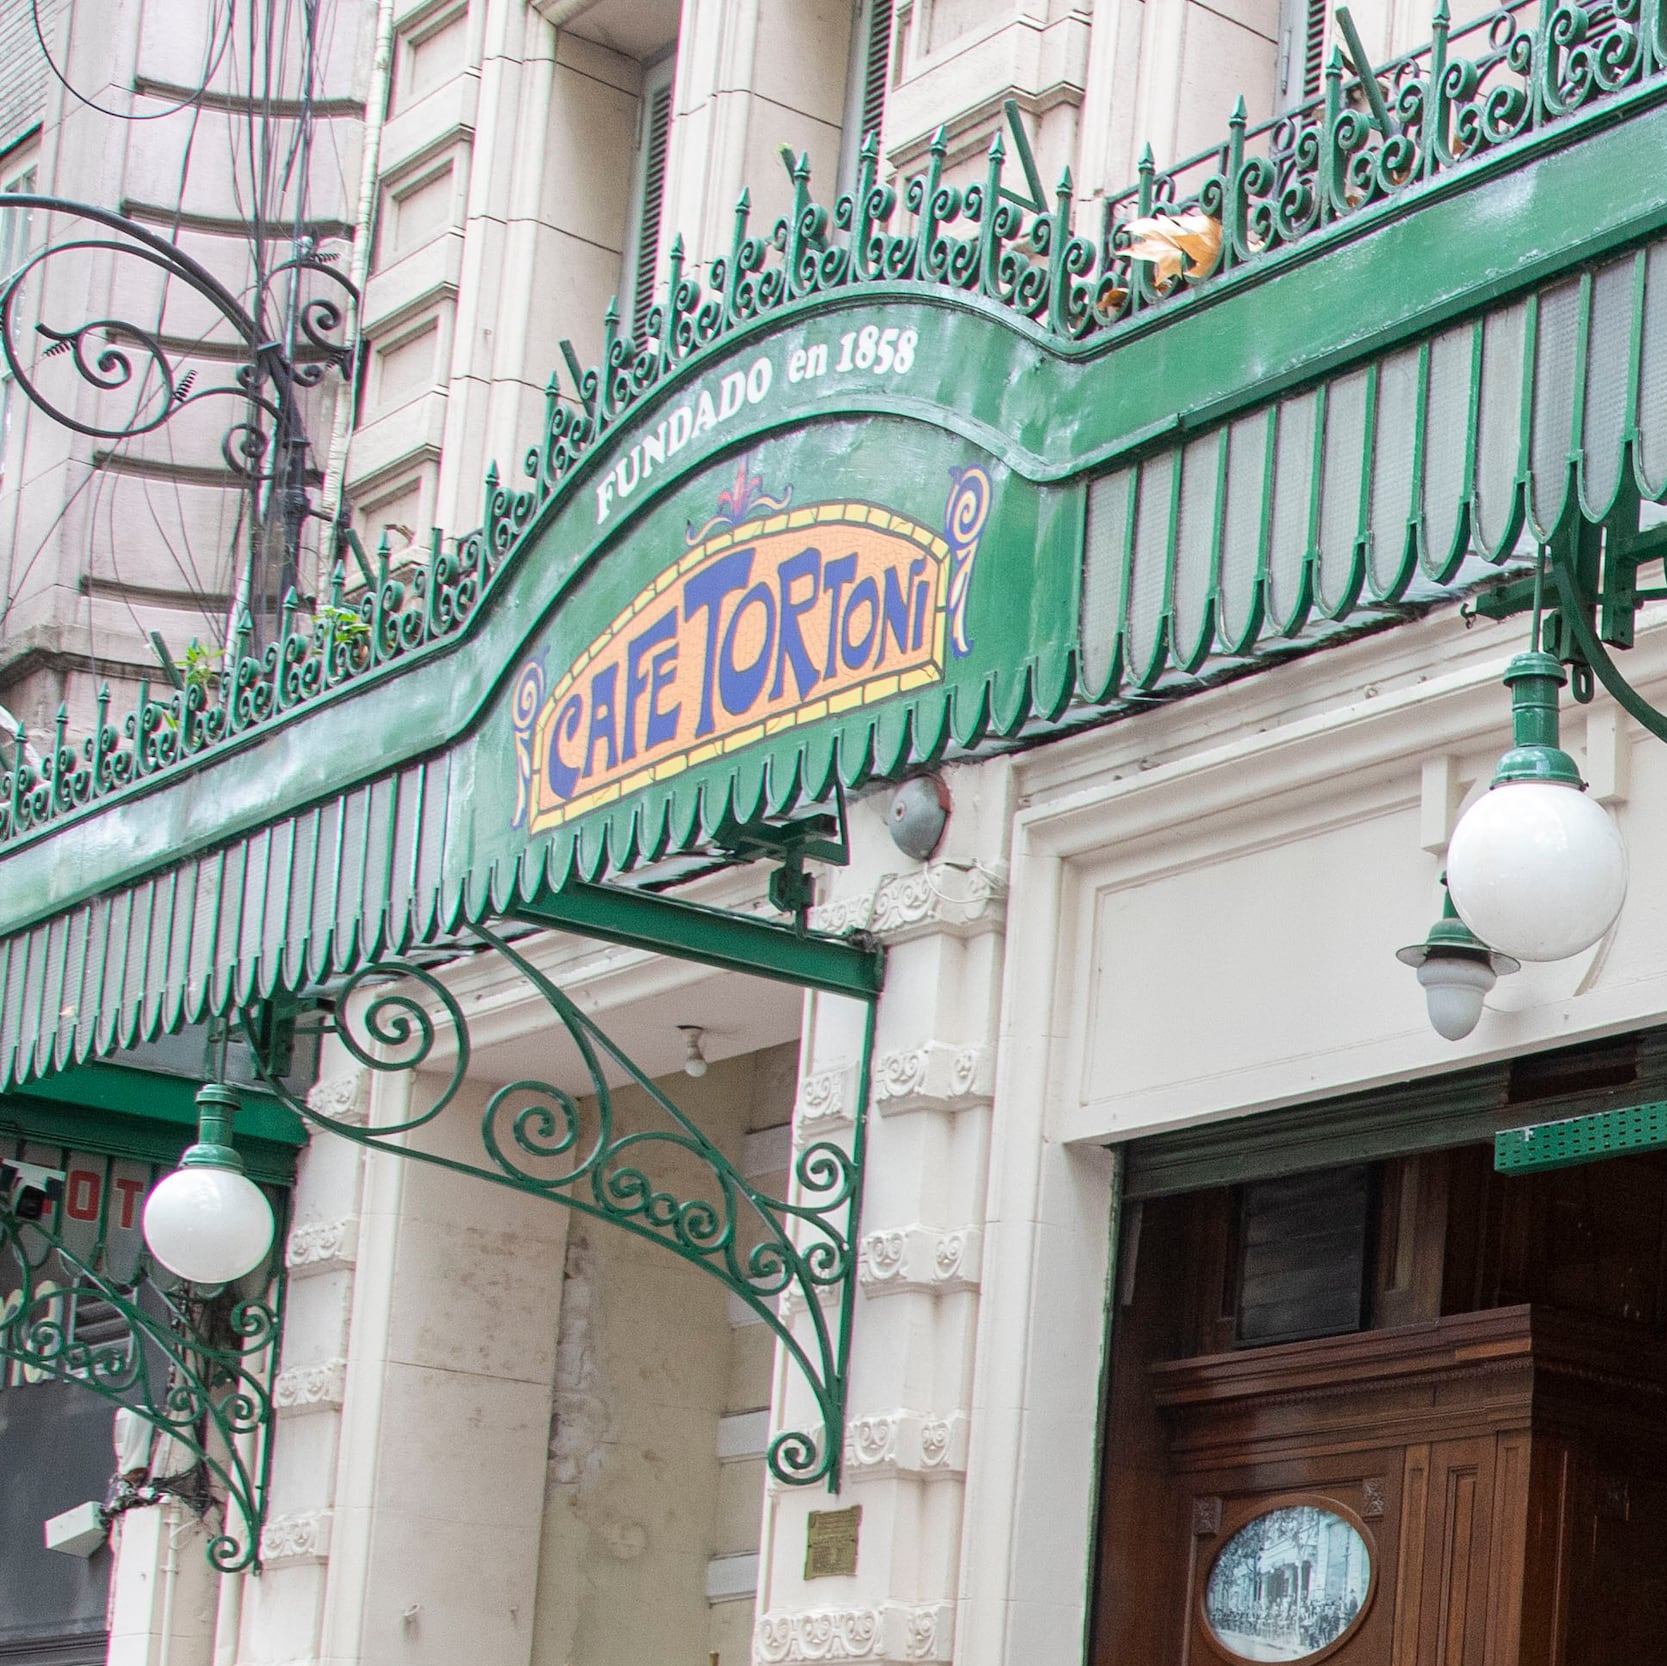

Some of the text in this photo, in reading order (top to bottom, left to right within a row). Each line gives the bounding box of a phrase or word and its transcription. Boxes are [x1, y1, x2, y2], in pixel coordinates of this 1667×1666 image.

[596, 325, 919, 525] FUNDADO en 1858
[548, 548, 930, 798] CAFE TORTONI
